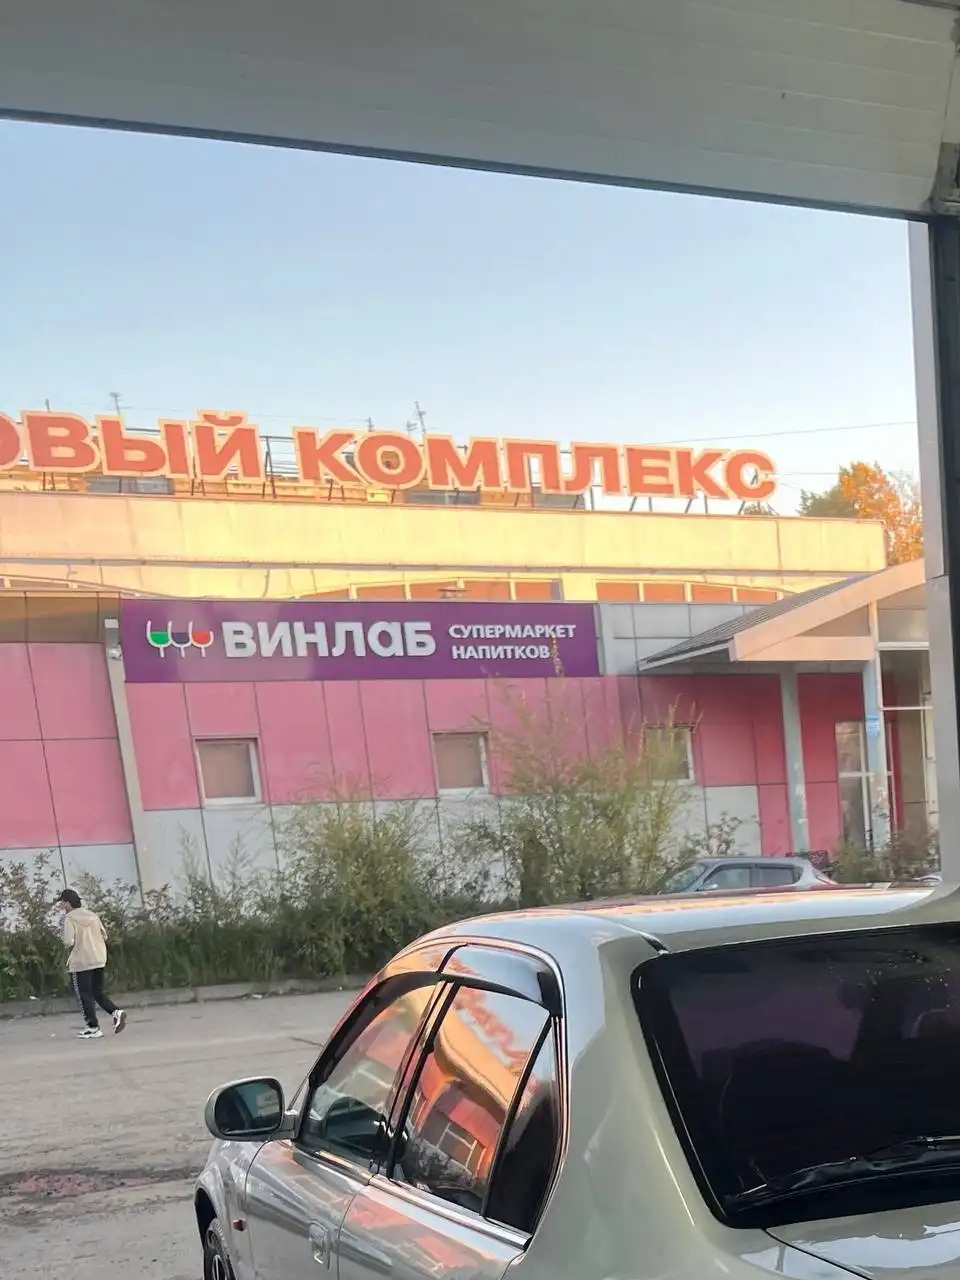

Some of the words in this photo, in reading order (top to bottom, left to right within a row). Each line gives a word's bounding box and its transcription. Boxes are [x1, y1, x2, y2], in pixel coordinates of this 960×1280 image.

[293, 426, 779, 500] КОМПЛЕКС
[448, 624, 576, 642] СУПЕРМАРКЕТ
[452, 644, 552, 660] НАПИТКОВ
